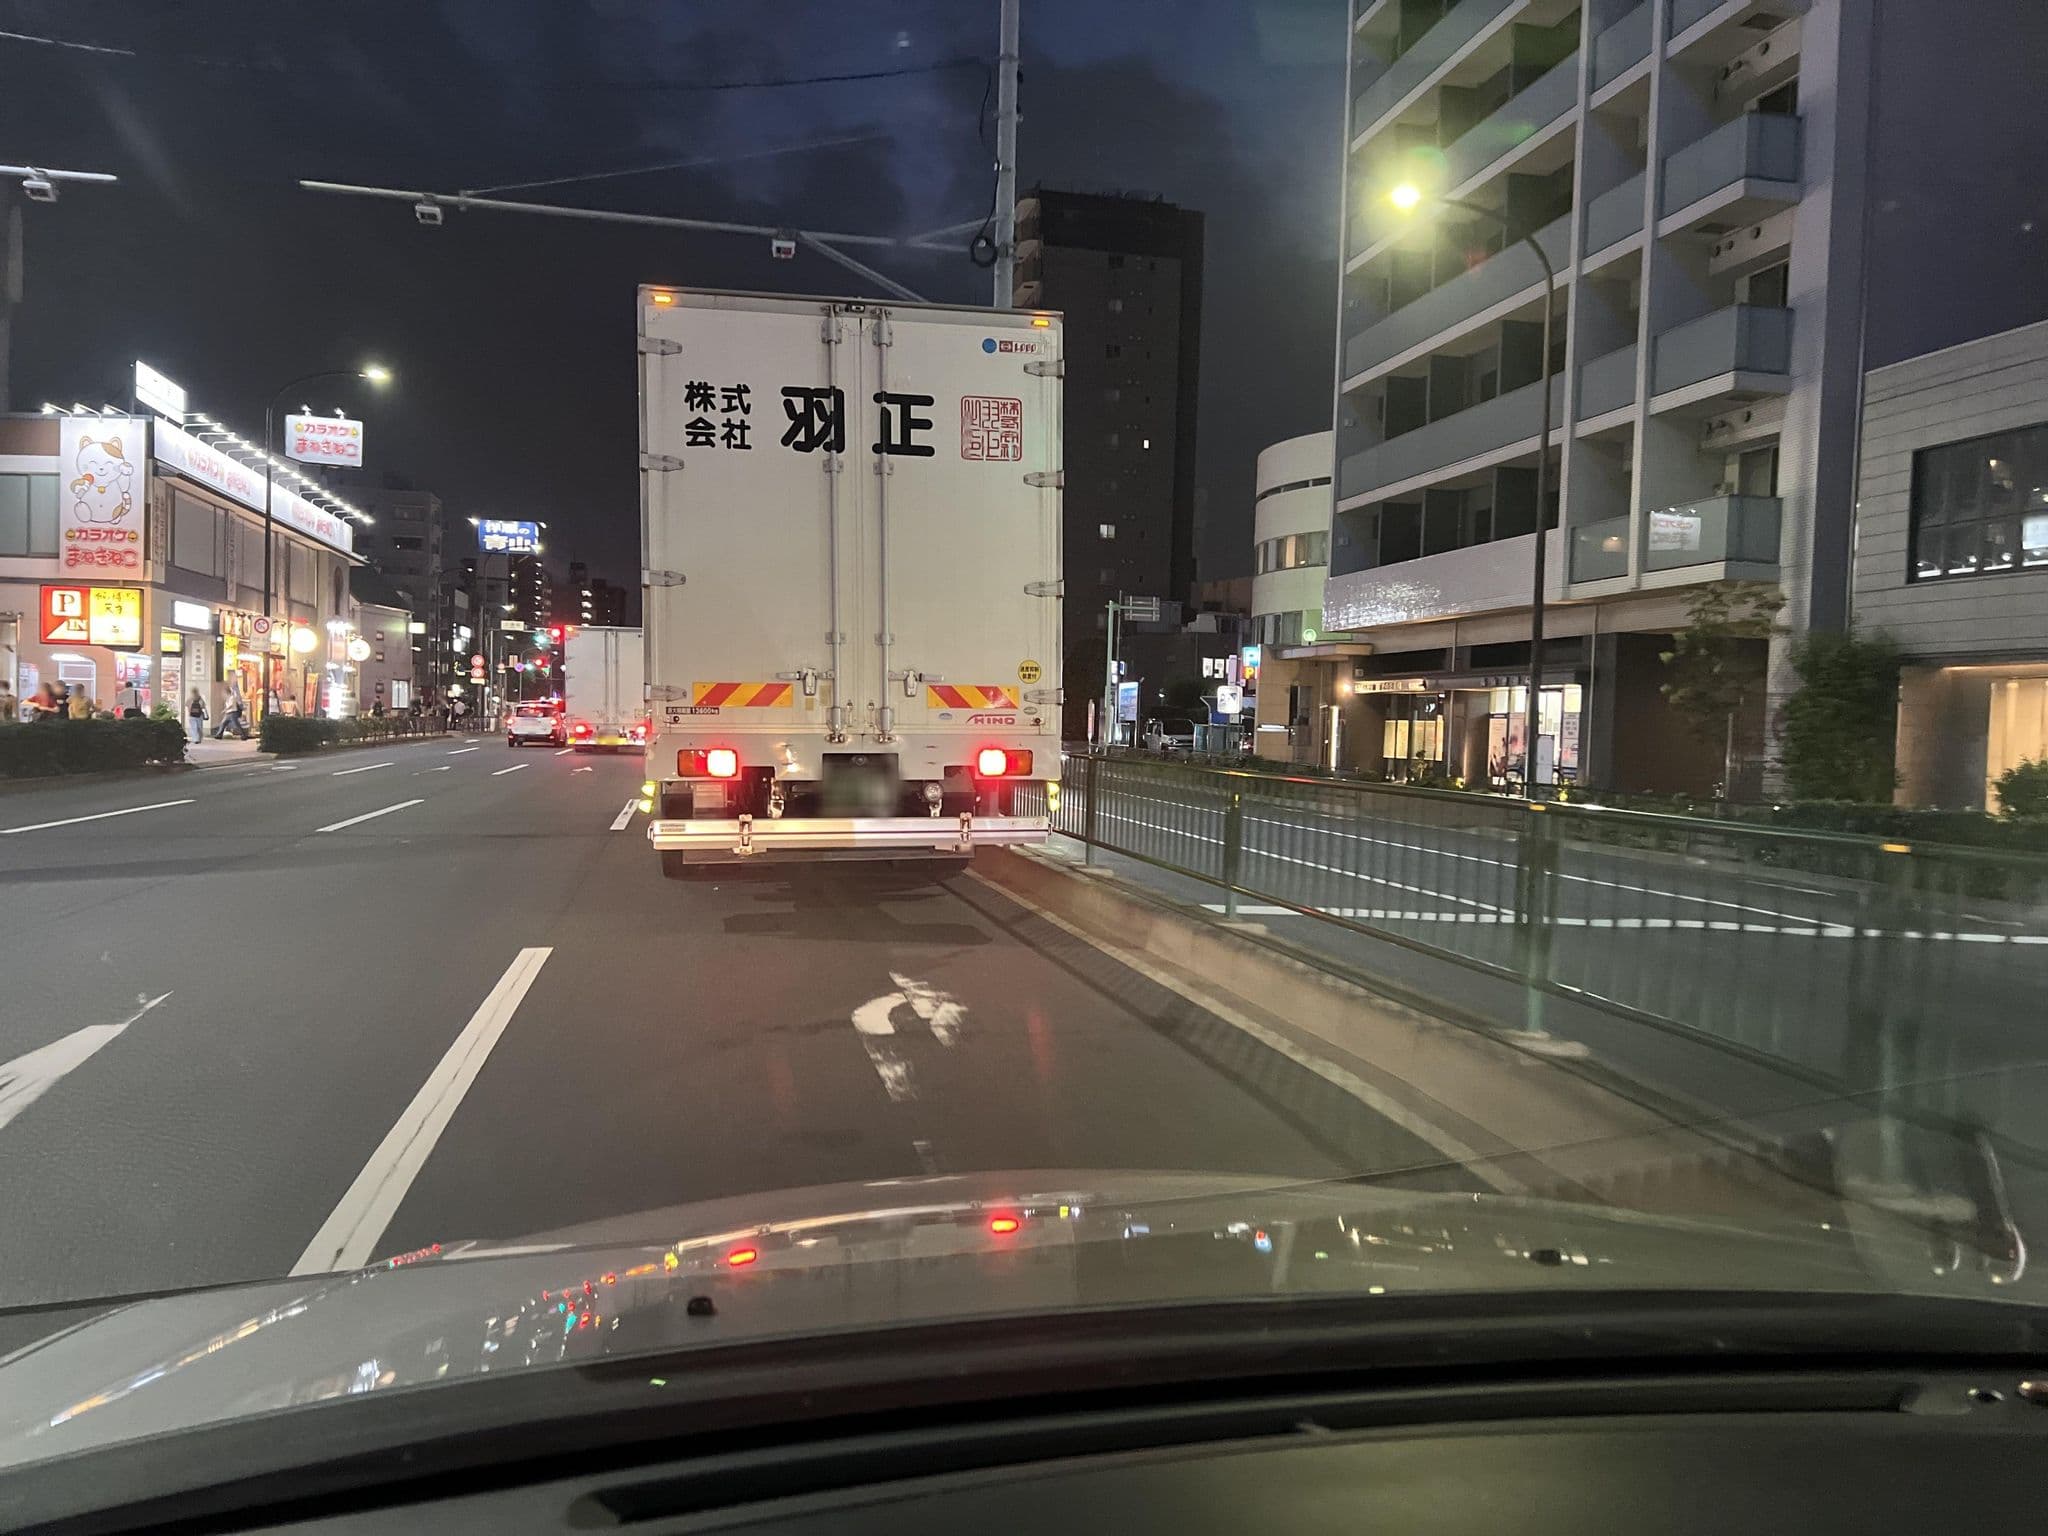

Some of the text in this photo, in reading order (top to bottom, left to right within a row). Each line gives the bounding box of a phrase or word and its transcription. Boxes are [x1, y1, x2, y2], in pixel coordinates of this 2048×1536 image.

[684, 381, 751, 415] 株式
[304, 423, 350, 436] カラオケ
[684, 416, 752, 450] 会社
[295, 437, 358, 457] まねきねこ
[75, 528, 128, 541] カラオケ
[65, 545, 138, 568] まねきねこ
[58, 594, 75, 612] P
[973, 716, 1016, 725] HINO
